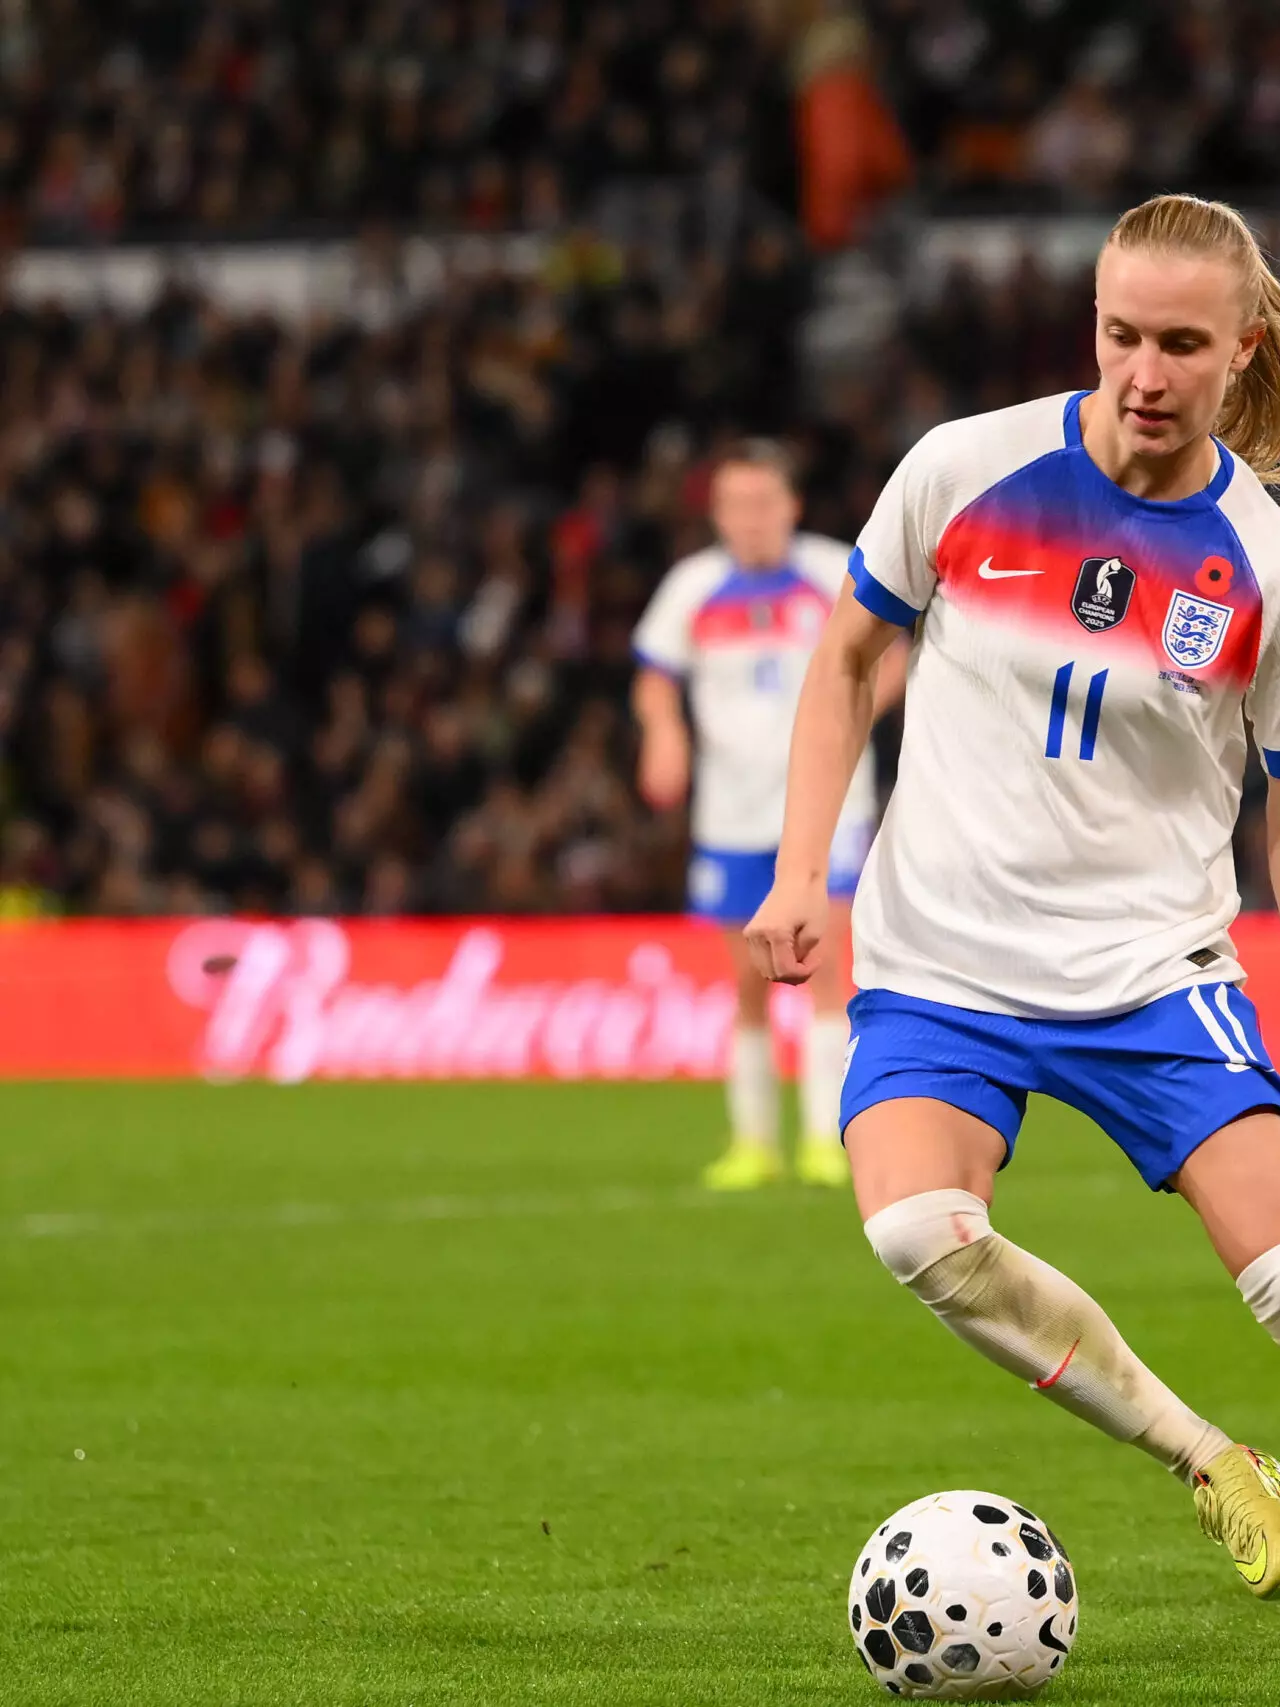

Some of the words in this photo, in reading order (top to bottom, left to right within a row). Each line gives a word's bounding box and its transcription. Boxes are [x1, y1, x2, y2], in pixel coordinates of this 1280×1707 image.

[1078, 607, 1115, 621] CHAMPIONS
[1081, 601, 1115, 615] EUROPEAN
[1085, 617, 1105, 627] 2025
[1044, 660, 1109, 761] 11
[1187, 982, 1262, 1073] 11
